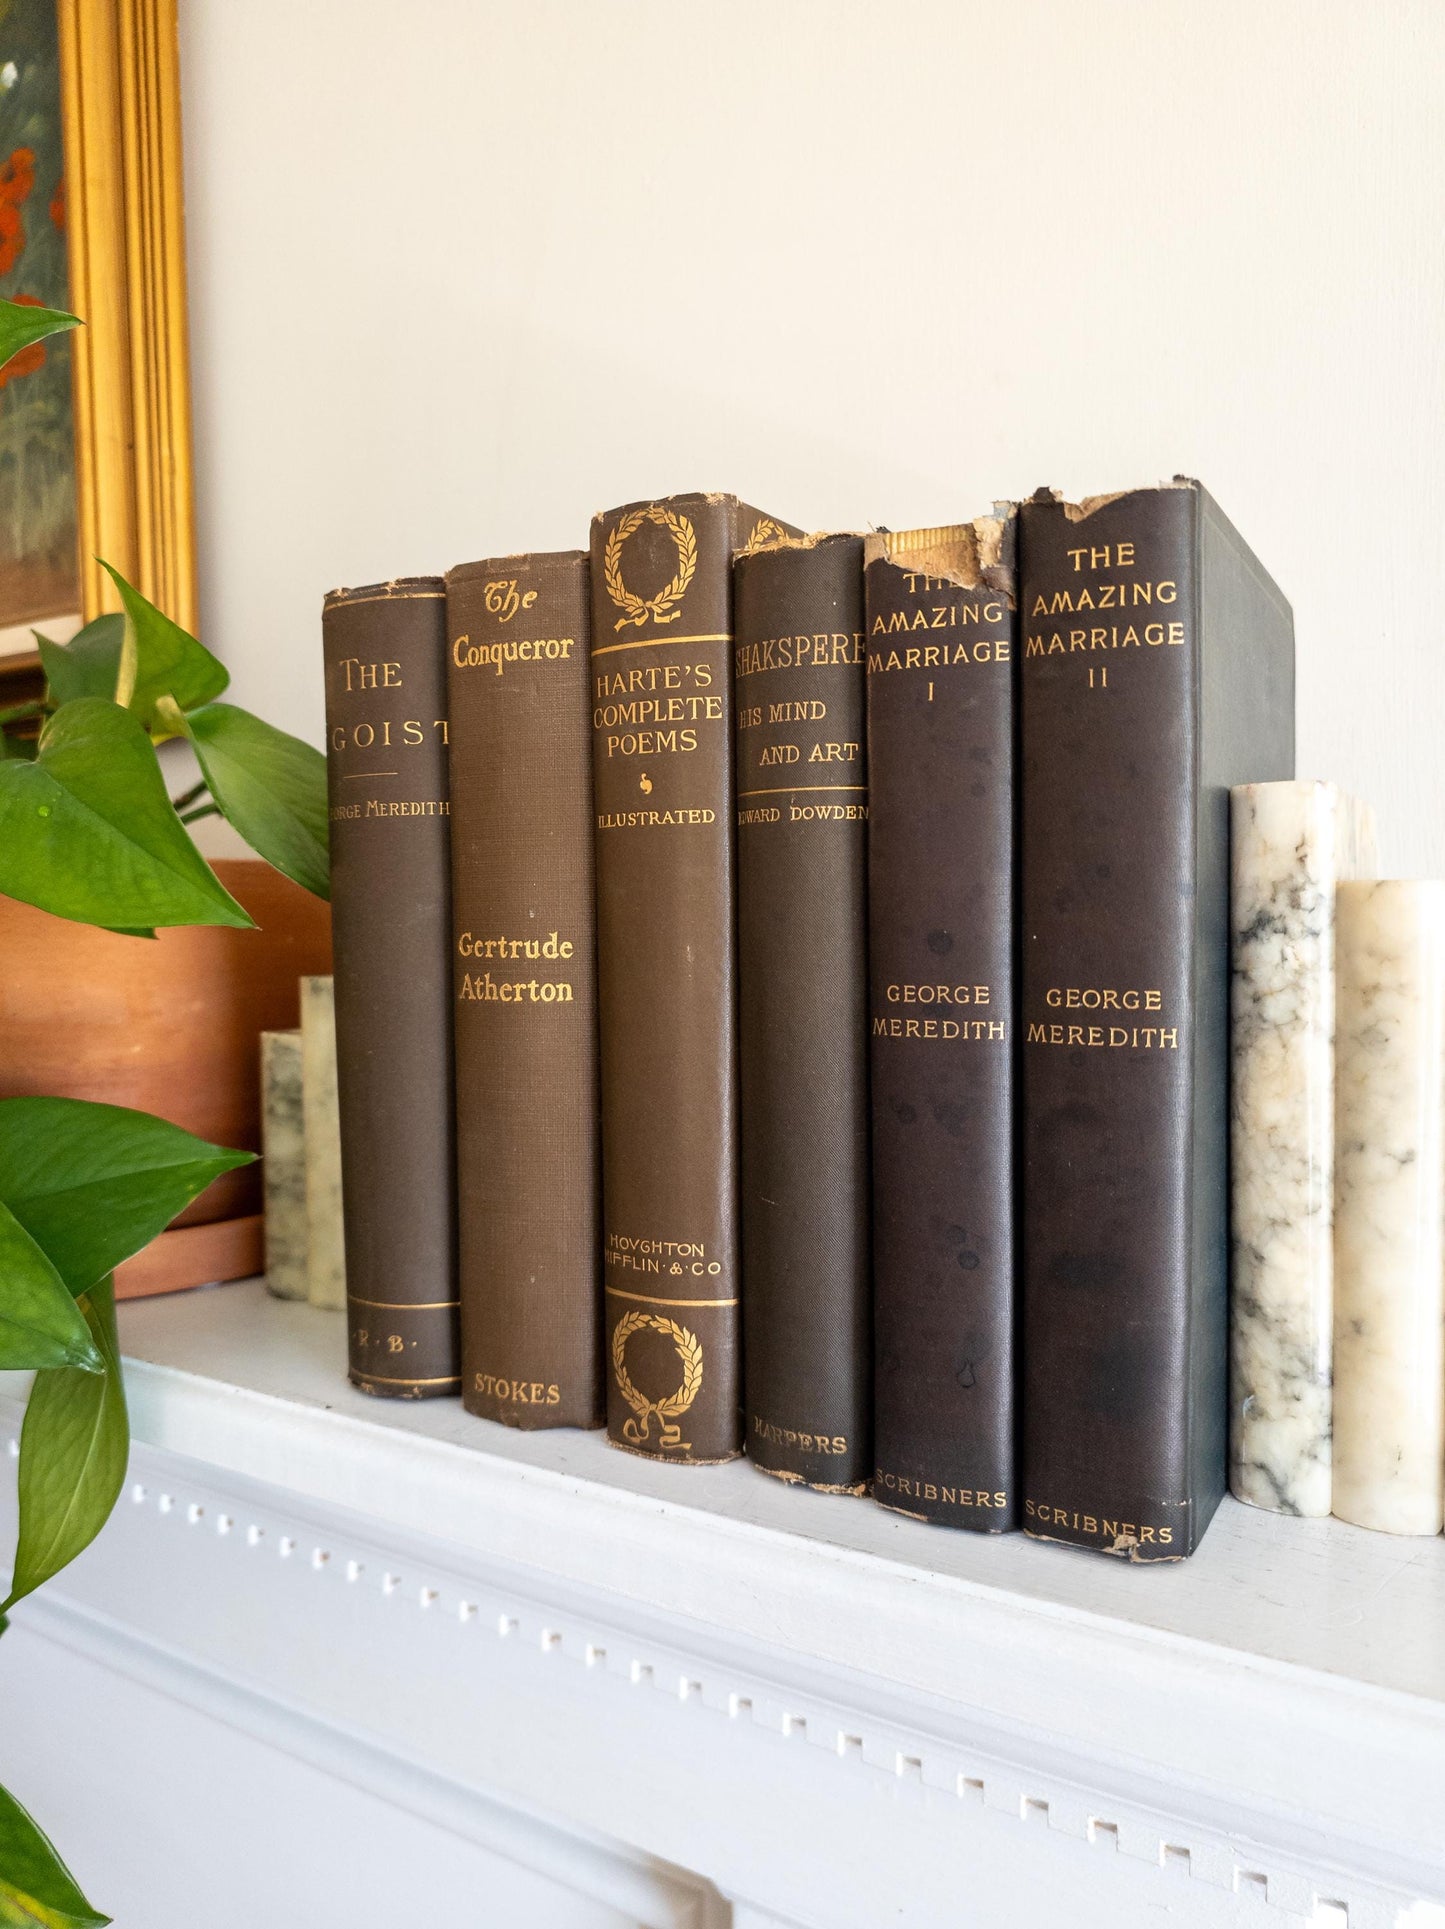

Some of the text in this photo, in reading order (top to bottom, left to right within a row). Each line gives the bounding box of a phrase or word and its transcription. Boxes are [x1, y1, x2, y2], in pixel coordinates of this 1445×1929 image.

[1068, 543, 1135, 572] THE
[484, 579, 538, 623] The
[1032, 581, 1178, 617] AMAZING
[871, 602, 1003, 636] AMAZING
[453, 634, 575, 676] Conqueror
[1026, 622, 1185, 658] MARRIAGE
[867, 641, 1010, 675] MARRIAGE
[340, 658, 402, 692] THE
[597, 663, 713, 698] HARTE'S
[1088, 667, 1108, 688] II
[927, 682, 935, 701] I
[593, 696, 723, 730] COMPLETE
[740, 700, 826, 729] HIS MIND
[332, 720, 450, 751] GOIST
[607, 729, 698, 757] POEMS
[759, 743, 859, 766] AND ART
[365, 800, 450, 817] MEREDITH
[598, 809, 716, 829] ILLUSTRATED
[790, 805, 868, 821] DOWDEN
[458, 931, 574, 959] Gertrude
[460, 972, 574, 1002] Atherton
[887, 985, 990, 1004] GEORGE
[1046, 989, 1162, 1011] GEORGE
[872, 1018, 1005, 1040] MEREDITH
[1027, 1023, 1178, 1049] MEREDITH
[475, 1373, 561, 1405] STOKES
[754, 1415, 848, 1455] HARPERS
[876, 1468, 1007, 1508] SCRIBNERS
[1025, 1500, 1173, 1544] SCRIBNERS
